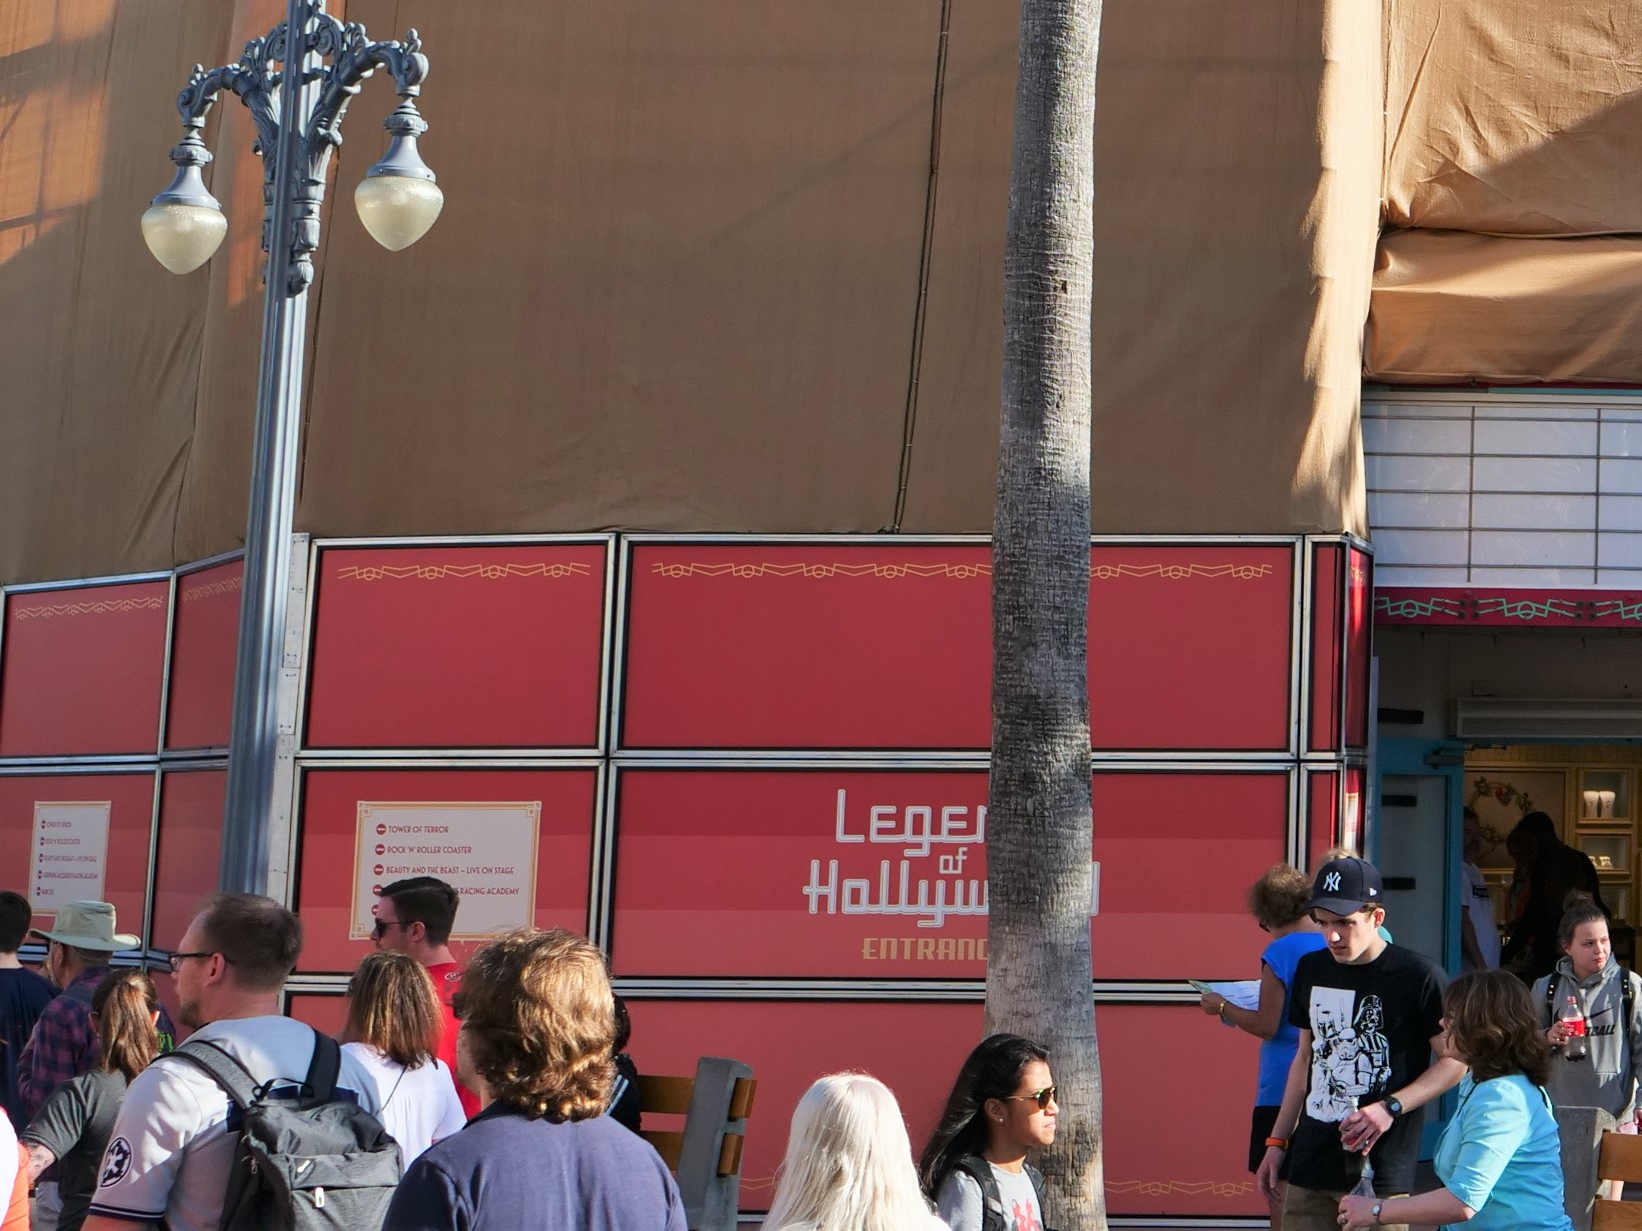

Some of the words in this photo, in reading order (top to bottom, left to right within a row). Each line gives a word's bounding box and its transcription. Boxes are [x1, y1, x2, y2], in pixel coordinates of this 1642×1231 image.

[388, 825, 411, 833] TOWER
[412, 825, 423, 833] OF
[424, 825, 449, 833] TERROR
[836, 789, 988, 857] Lege
[387, 846, 406, 854] ROCK
[417, 846, 441, 854] ROLLER
[442, 846, 472, 854] COASTER
[386, 866, 410, 874] BEAUTY
[410, 866, 426, 874] AND
[427, 866, 438, 874] THE
[439, 866, 459, 874] BEAST
[939, 847, 968, 874] of
[460, 887, 485, 895] RACING
[1323, 871, 1341, 891] NY
[803, 860, 1100, 927] Hollyw
[862, 937, 988, 960] ENTRANC
